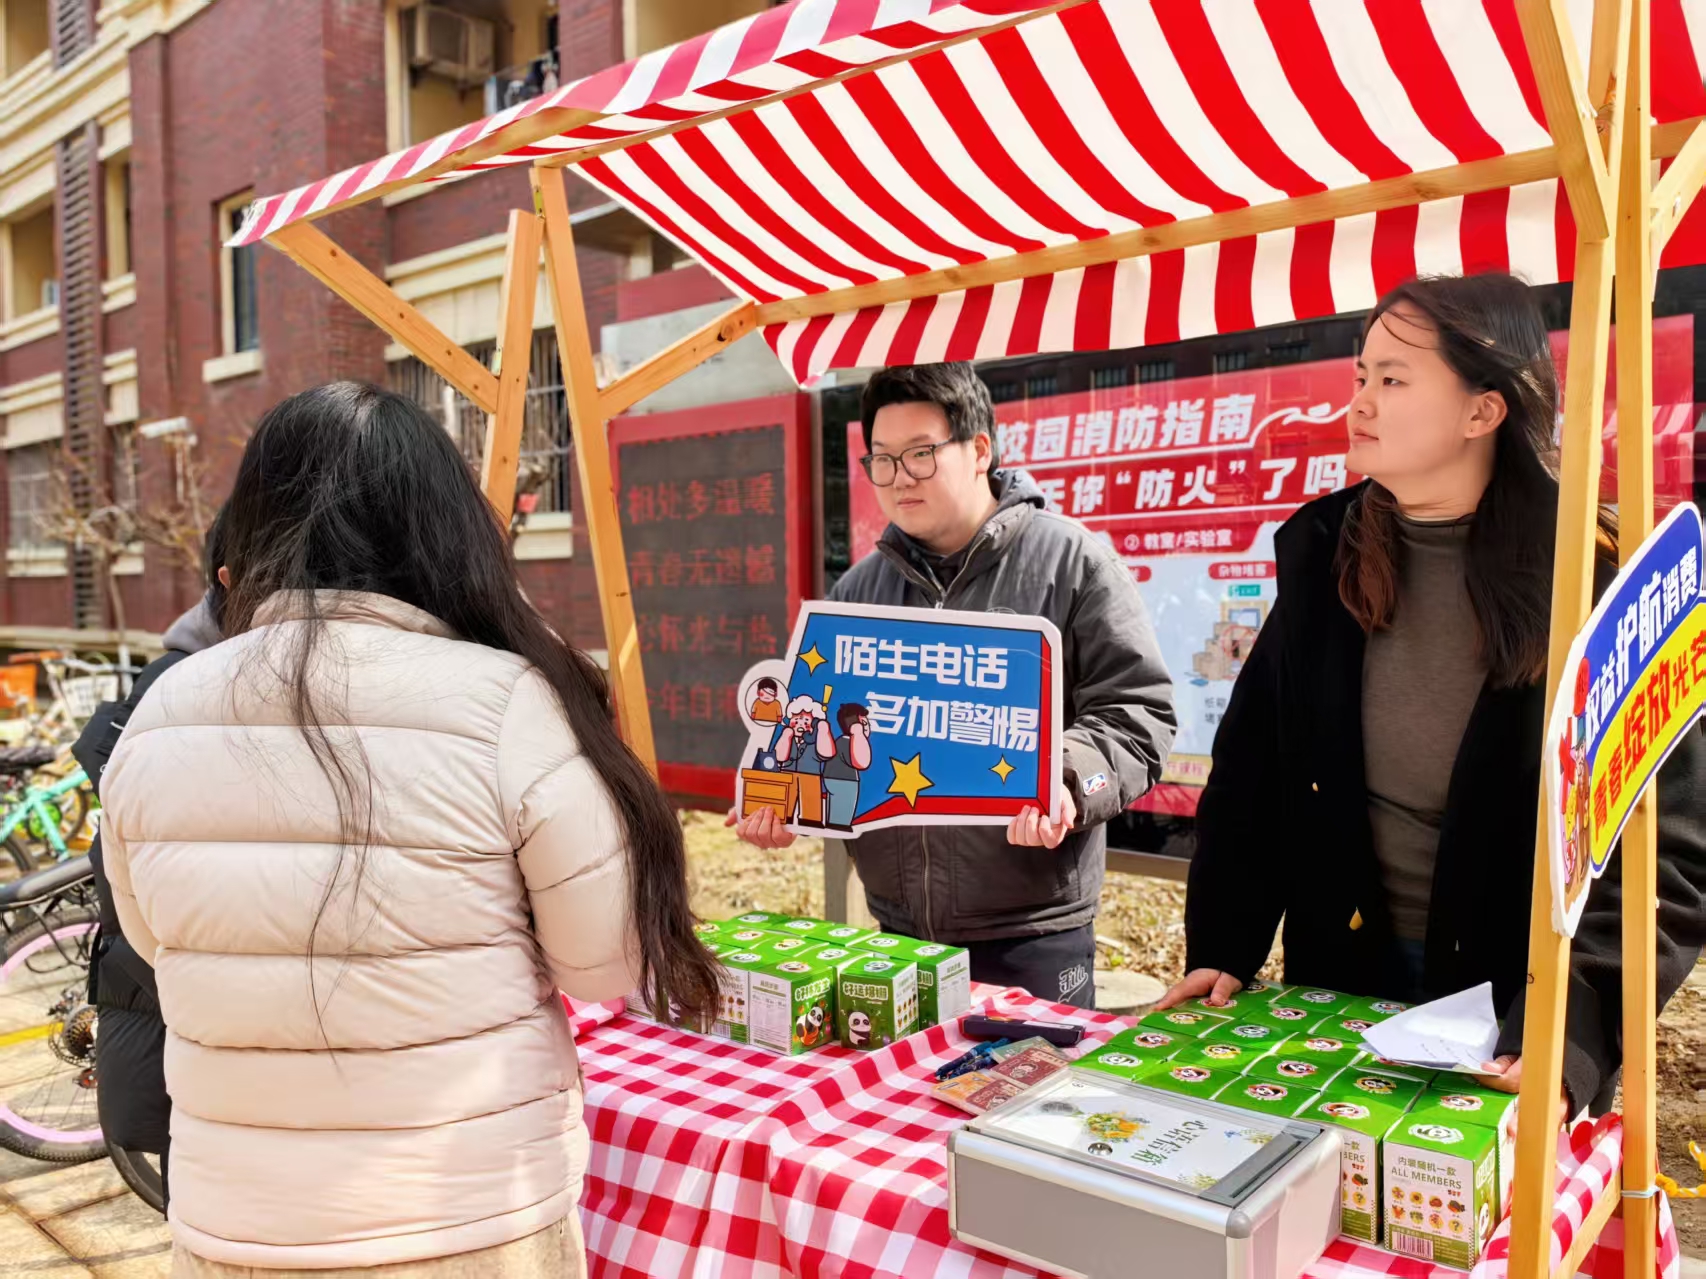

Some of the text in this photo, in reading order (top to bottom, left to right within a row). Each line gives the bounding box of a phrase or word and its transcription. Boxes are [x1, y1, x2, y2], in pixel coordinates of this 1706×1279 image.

[996, 394, 1256, 464] 校园消防指南
[834, 634, 1008, 691] 陌生电话
[865, 691, 1040, 752] 多加警惕
[1391, 1166, 1462, 1190] ALL MEMBERS
